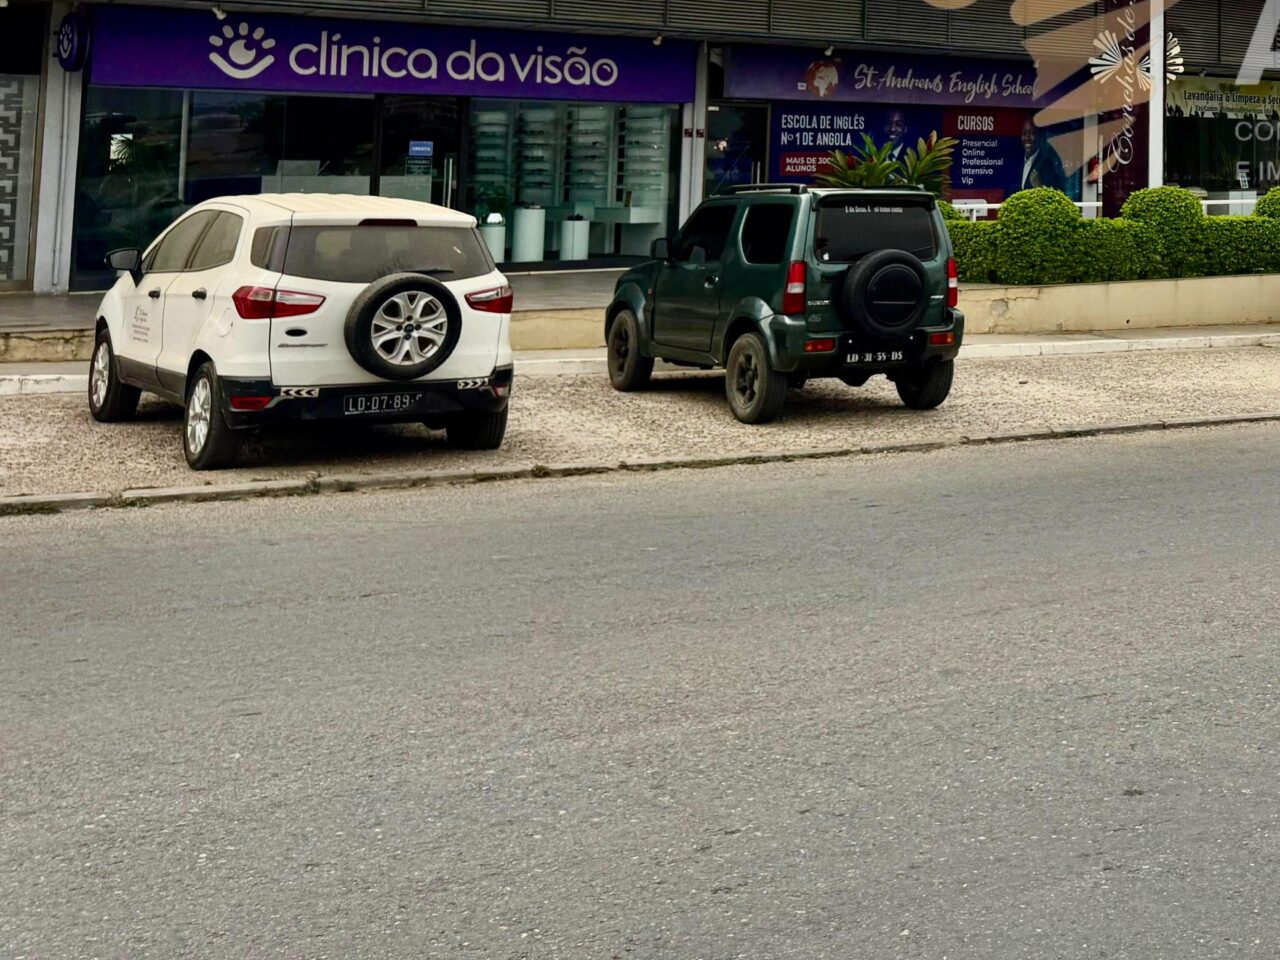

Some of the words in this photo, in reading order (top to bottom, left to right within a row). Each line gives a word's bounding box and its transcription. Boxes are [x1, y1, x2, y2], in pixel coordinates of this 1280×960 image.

[1116, 10, 1136, 41] de
[289, 30, 438, 79] clínica
[446, 39, 505, 82] da
[509, 46, 619, 87] visão
[949, 71, 998, 104] English
[1184, 90, 1223, 102] Lavandaria
[1225, 92, 1230, 103] &
[1232, 92, 1260, 105] Limpeza
[1107, 46, 1136, 173] Conchas
[781, 114, 818, 129] ESCOLA
[820, 115, 832, 129] DE
[834, 114, 864, 130] INGLÊS
[957, 115, 994, 131] CURSOS
[802, 132, 814, 146] DE
[816, 132, 852, 146] ANGOLA
[962, 139, 998, 148] Presencial
[962, 148, 986, 156] Online
[962, 167, 994, 175] Intensivo
[961, 176, 974, 186] Vip
